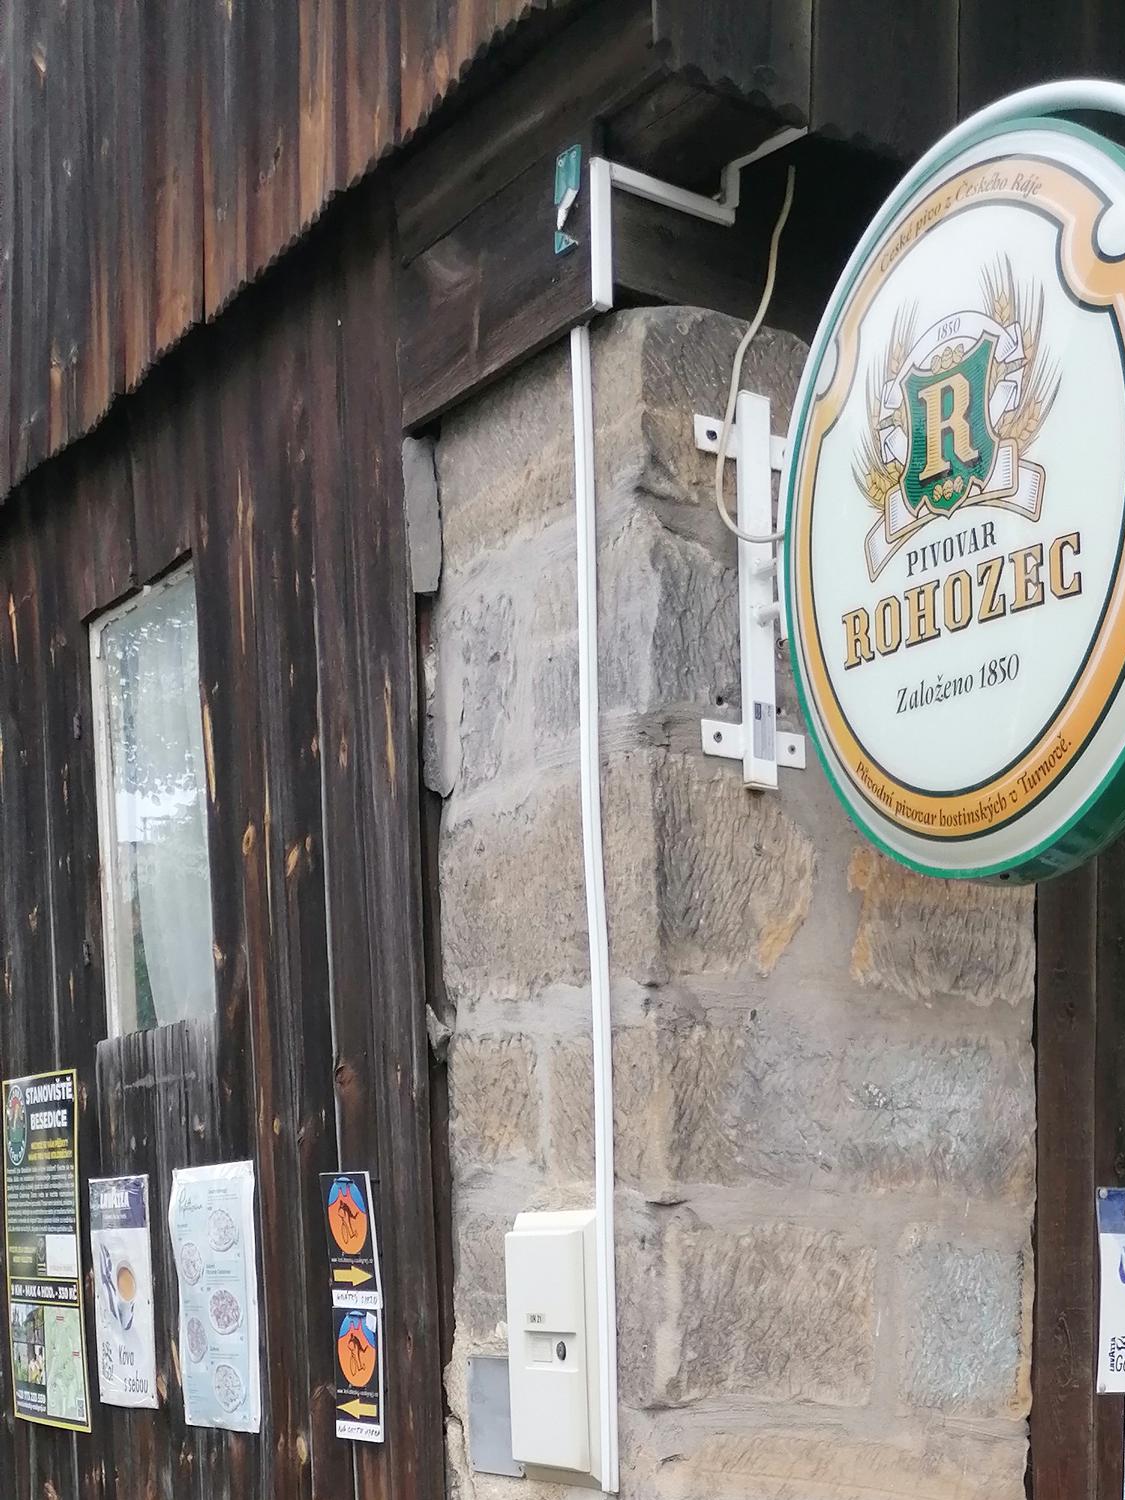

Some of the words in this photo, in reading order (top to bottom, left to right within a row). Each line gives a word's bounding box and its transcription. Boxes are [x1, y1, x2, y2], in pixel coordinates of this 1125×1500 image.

[914, 203, 942, 238] pivo
[1011, 173, 1043, 198] Ráje
[935, 317, 962, 343] 1850
[918, 371, 983, 484] R
[905, 520, 998, 578] PIVOVAR
[841, 531, 1084, 671] ROHOZEC
[895, 672, 975, 715] Založeno
[978, 652, 1021, 689] 1850
[895, 799, 938, 826] pivovar
[1009, 789, 1018, 803] v
[1016, 732, 1073, 794] Turnově.
[25, 1076, 73, 1105] STANOVIŠTĚ
[30, 1109, 68, 1130] BESEDICE
[129, 1369, 149, 1394] sebou
